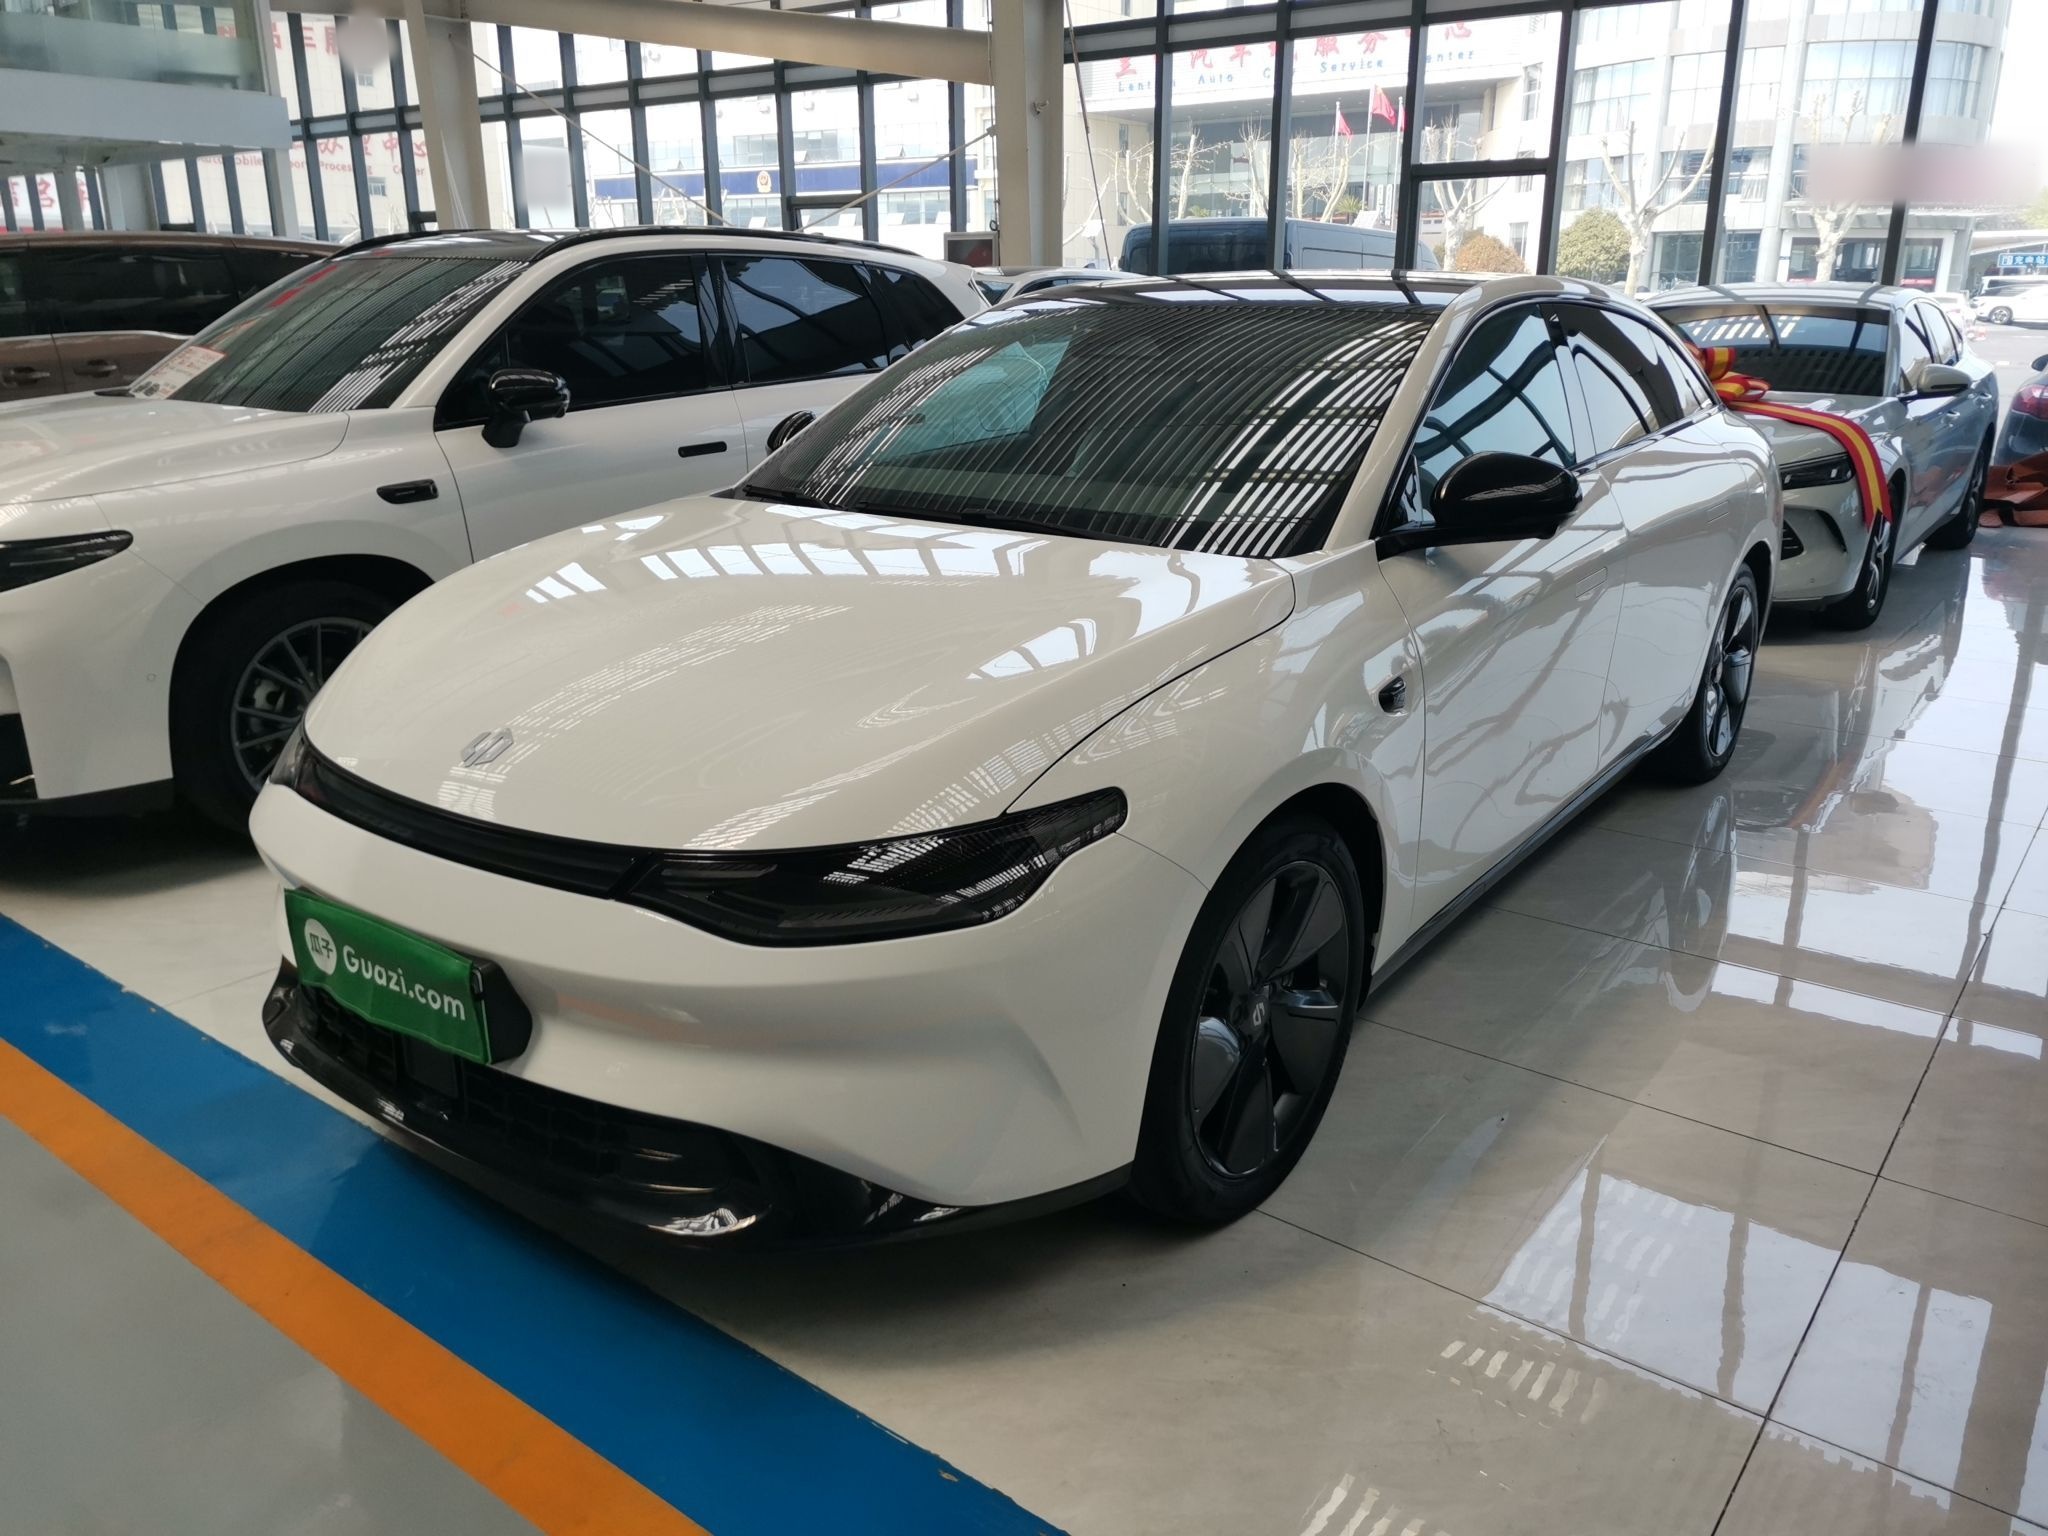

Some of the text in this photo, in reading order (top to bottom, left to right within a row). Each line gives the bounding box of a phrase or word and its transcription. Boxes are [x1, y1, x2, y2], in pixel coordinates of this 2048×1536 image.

[1198, 74, 1234, 85] Auto
[1320, 58, 1385, 73] Service
[1425, 50, 1475, 64] enter
[309, 932, 334, 960] 瓜子
[342, 944, 467, 1021] Guazi.com
